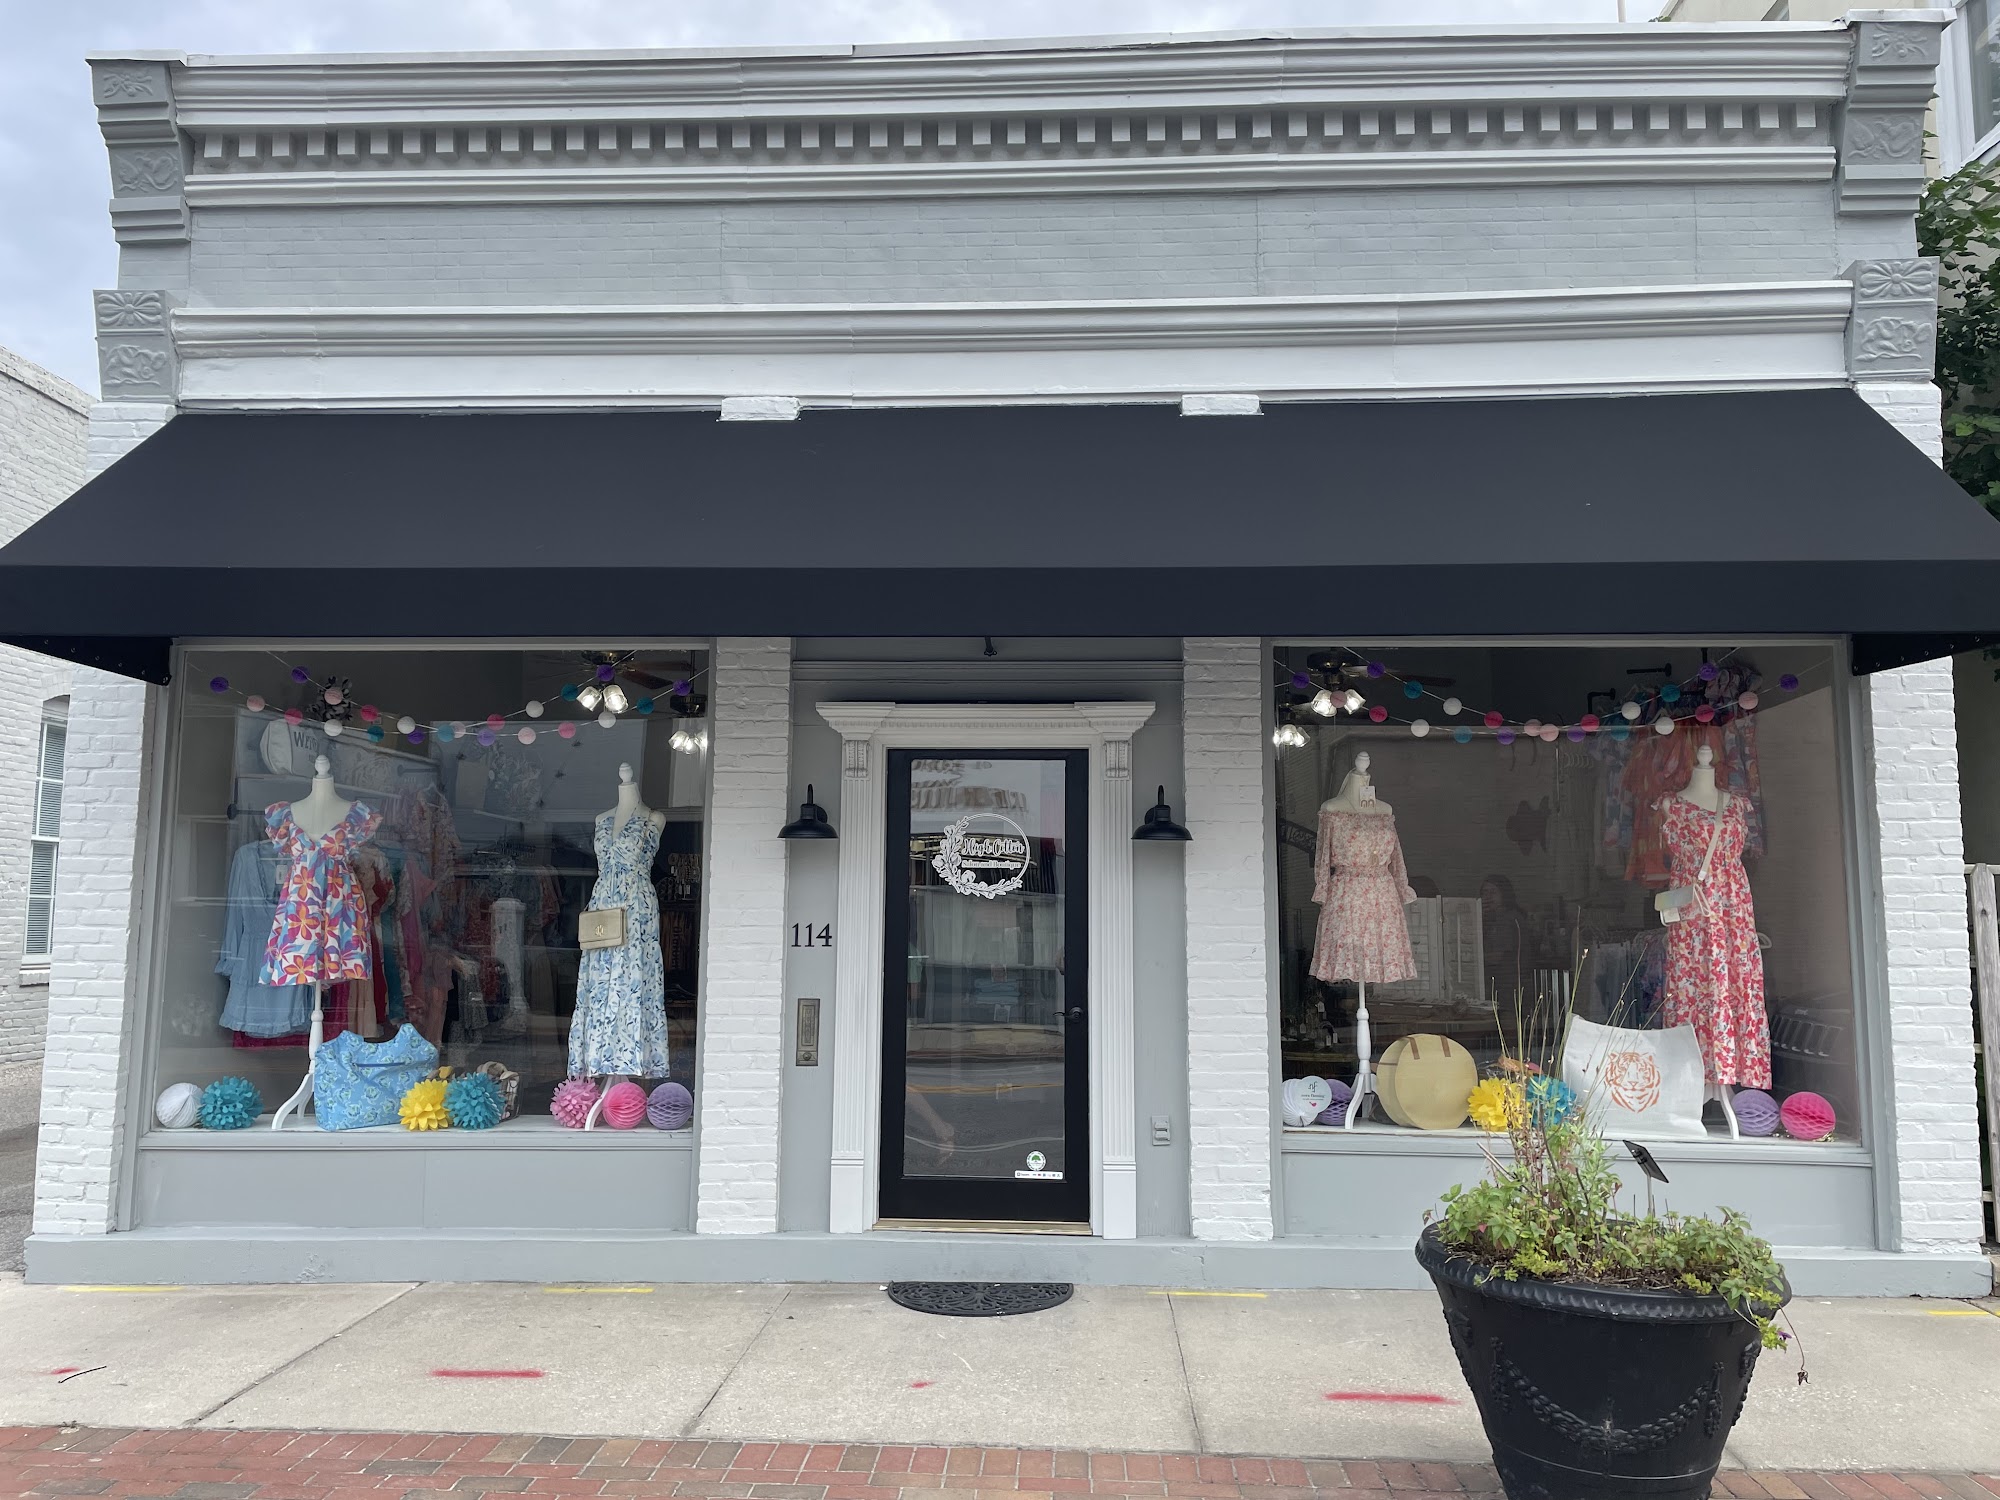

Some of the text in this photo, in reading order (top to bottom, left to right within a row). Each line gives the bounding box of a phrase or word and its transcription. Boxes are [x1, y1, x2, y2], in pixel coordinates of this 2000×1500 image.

[961, 838, 1025, 857] High Cotton
[791, 922, 833, 948] 114
